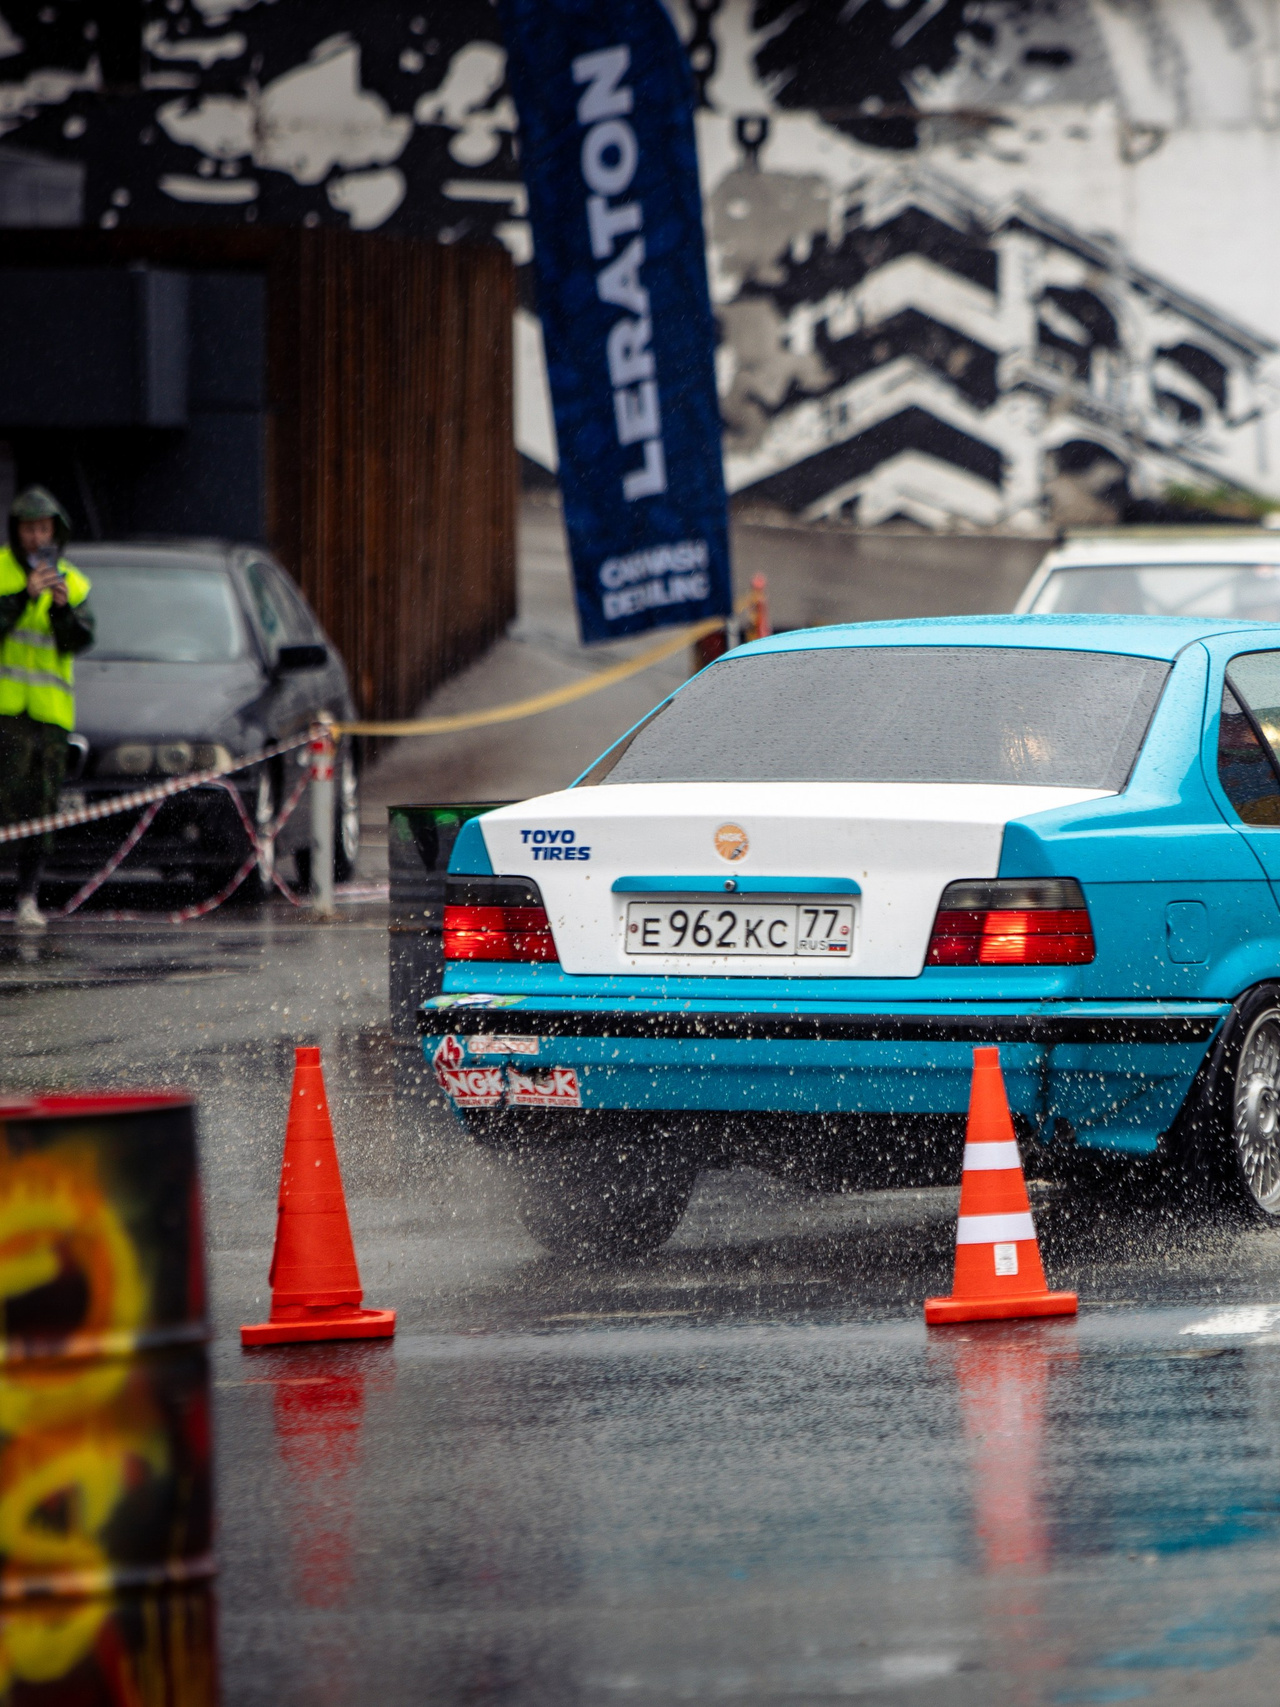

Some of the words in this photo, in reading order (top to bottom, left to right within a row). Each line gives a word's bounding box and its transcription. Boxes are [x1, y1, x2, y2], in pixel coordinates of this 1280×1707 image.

[571, 44, 668, 502] LERATON
[520, 830, 575, 844] TOYO
[803, 909, 839, 938] 77
